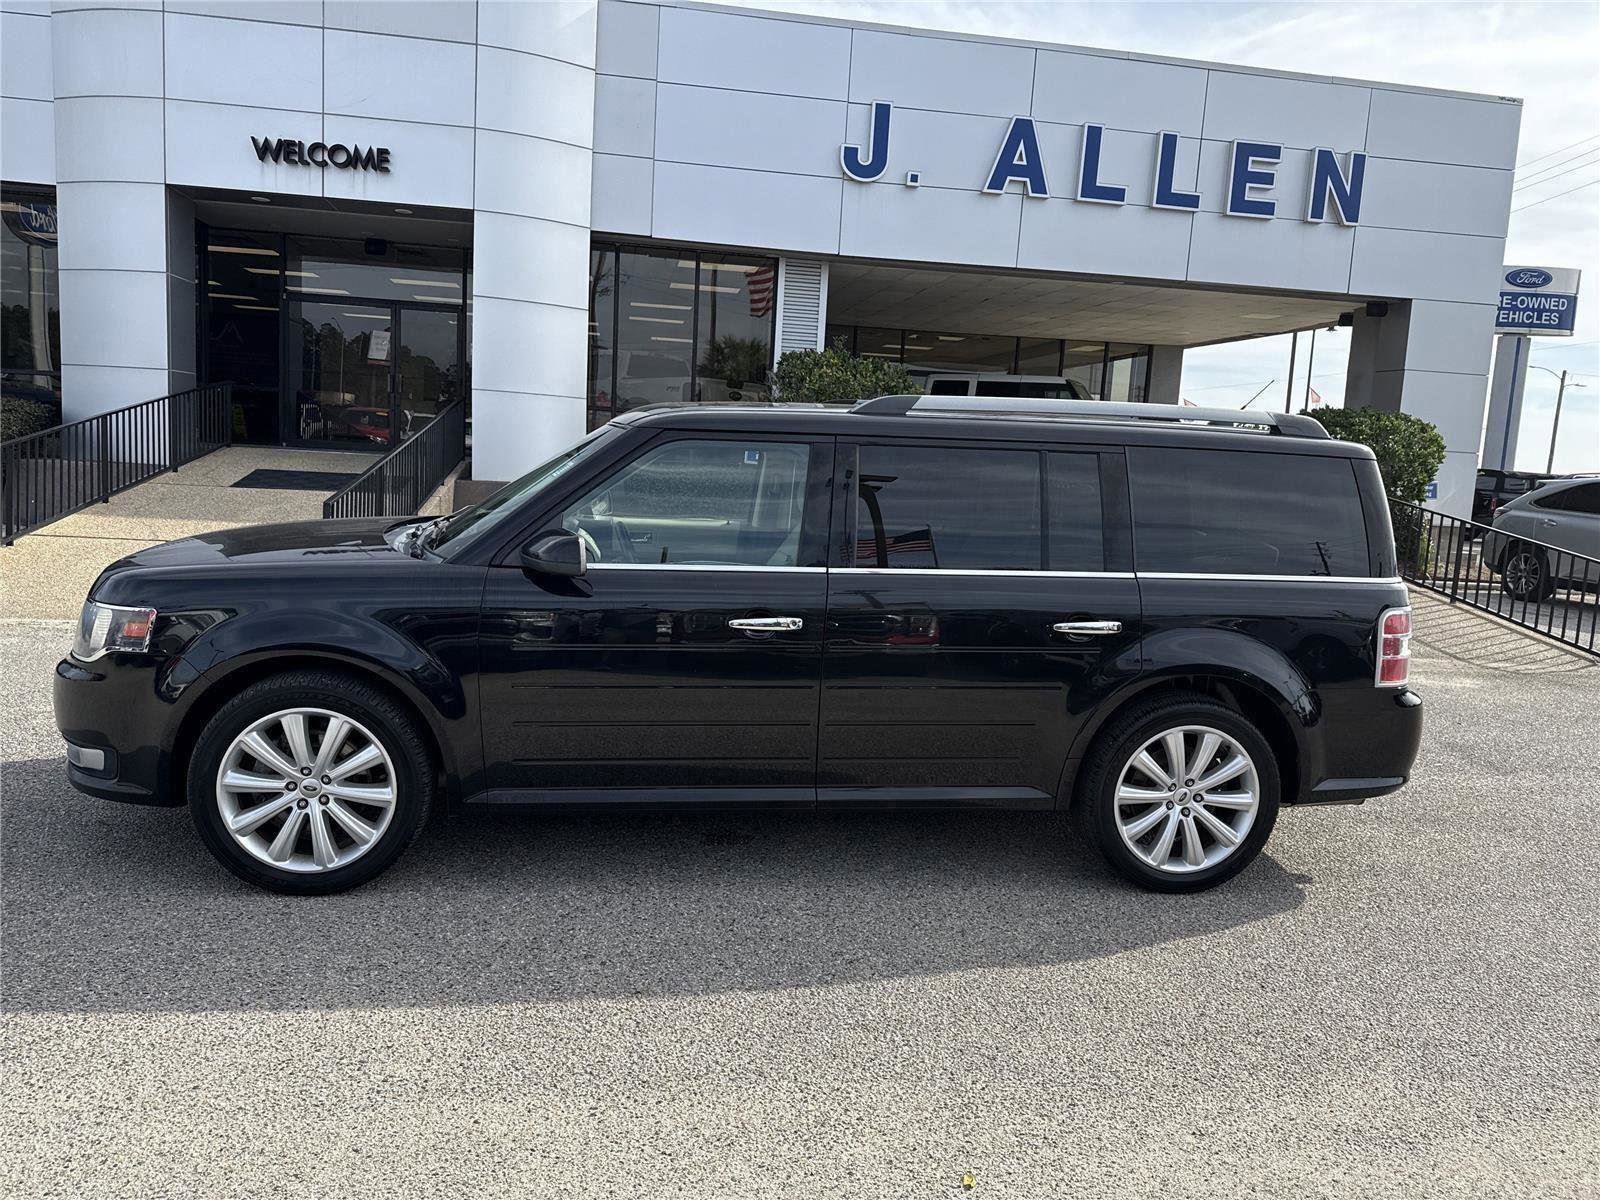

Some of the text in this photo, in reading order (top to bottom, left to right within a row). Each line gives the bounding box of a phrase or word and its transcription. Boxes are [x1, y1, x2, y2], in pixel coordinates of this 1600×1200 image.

[250, 135, 391, 173] WELCOME
[840, 101, 1368, 226] J. ALLEN
[1516, 271, 1545, 284] Ford
[1497, 310, 1559, 324] EHICLES
